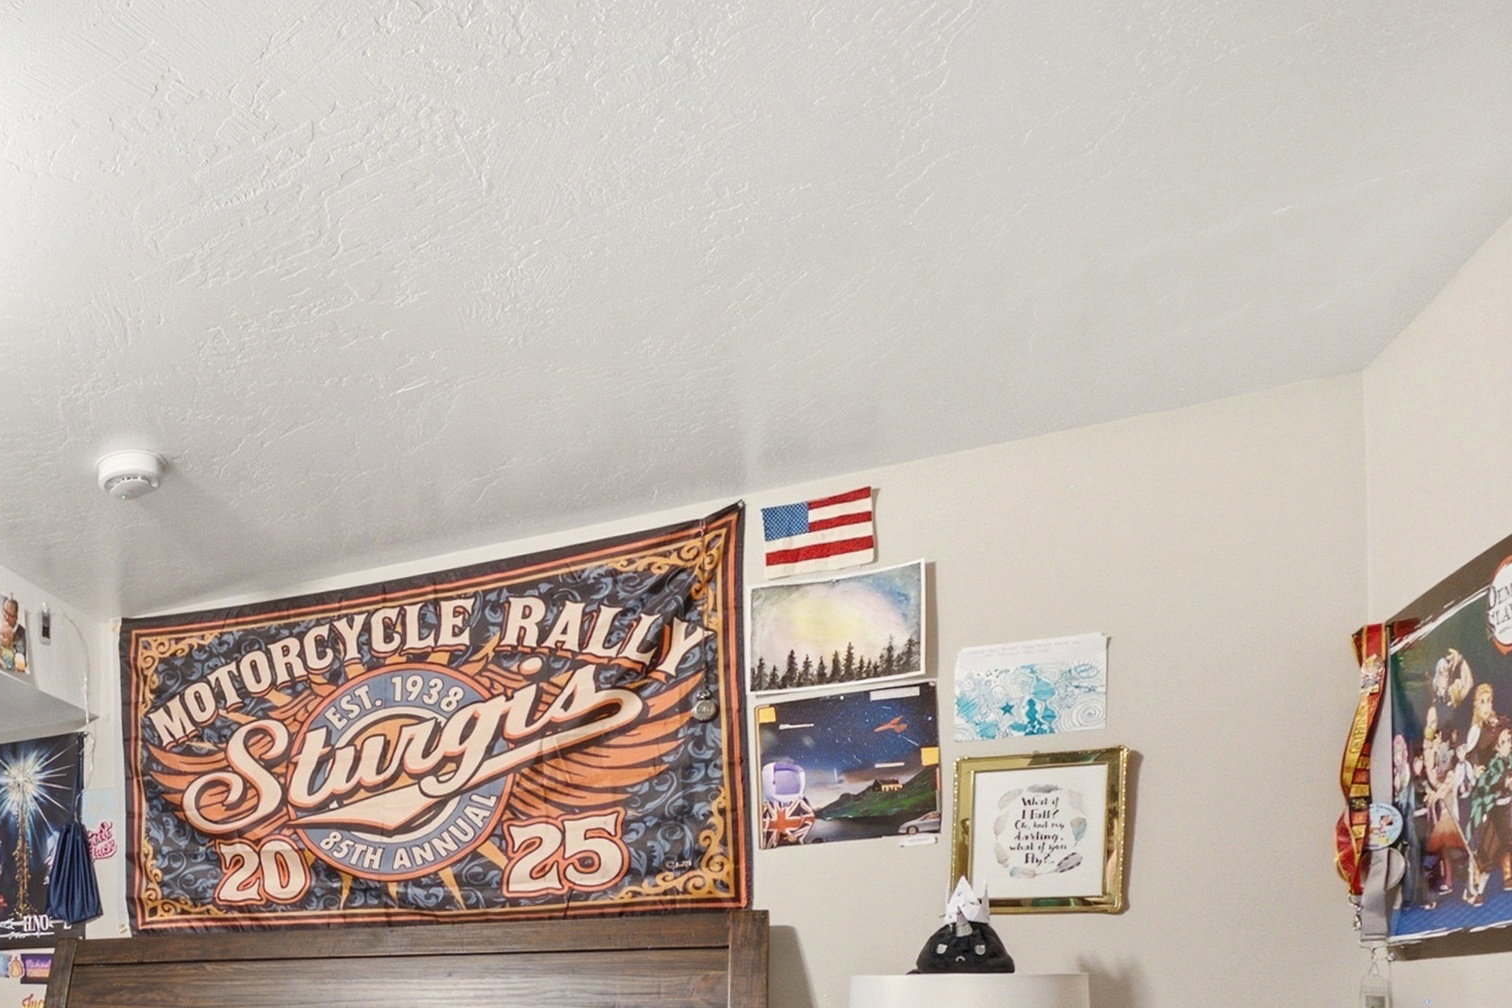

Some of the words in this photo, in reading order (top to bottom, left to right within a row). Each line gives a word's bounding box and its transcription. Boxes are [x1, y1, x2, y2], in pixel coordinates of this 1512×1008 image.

[148, 598, 476, 749] MOTORCYCLE
[496, 597, 717, 683] RALLY
[326, 684, 383, 731] EST.
[391, 674, 465, 713] 1938
[184, 656, 643, 835] Sturgis
[216, 836, 310, 903] 20
[506, 809, 628, 895] 25
[319, 830, 383, 870] 85TH
[392, 792, 498, 871] ANNUAL
